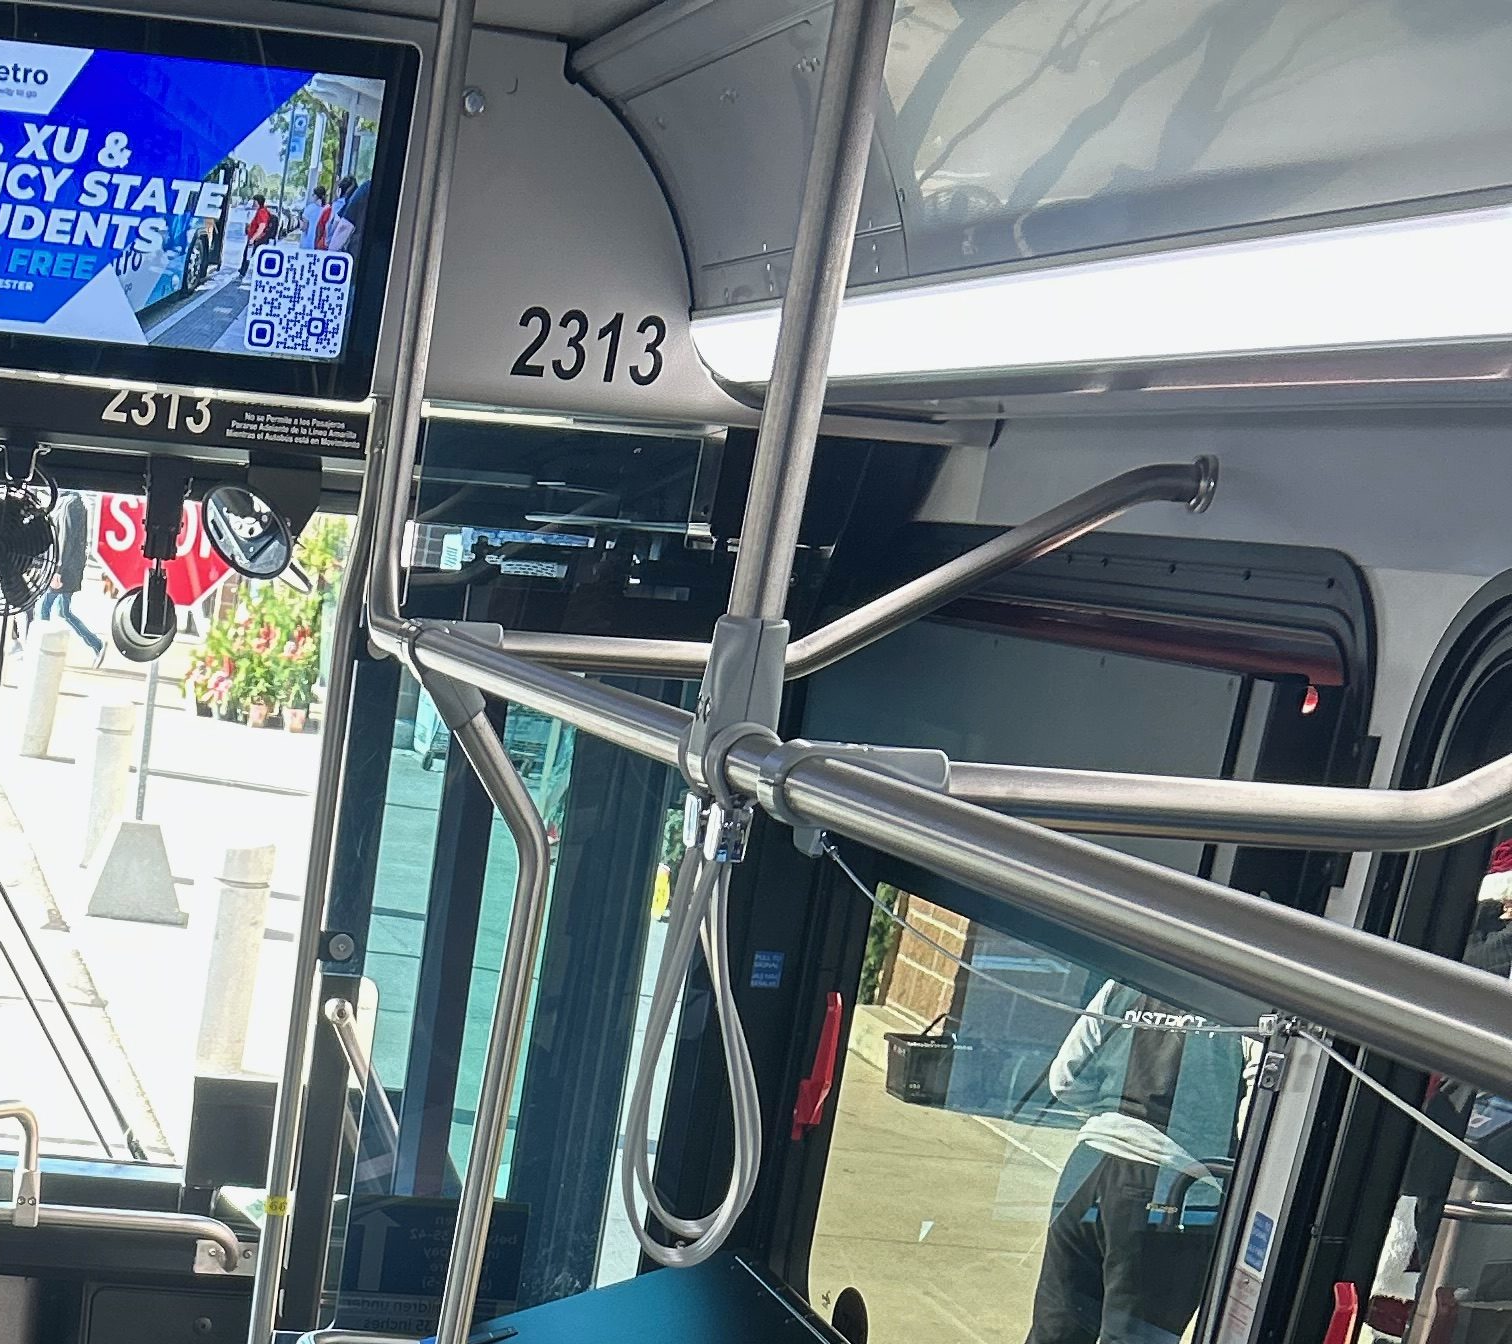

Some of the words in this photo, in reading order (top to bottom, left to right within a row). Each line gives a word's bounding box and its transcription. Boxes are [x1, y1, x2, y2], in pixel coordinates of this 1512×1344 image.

[15, 123, 89, 164] XU
[97, 131, 133, 169] &
[79, 170, 228, 219] STATE
[7, 248, 97, 280] FREE
[511, 306, 666, 386] 2313
[101, 389, 211, 434] 2313
